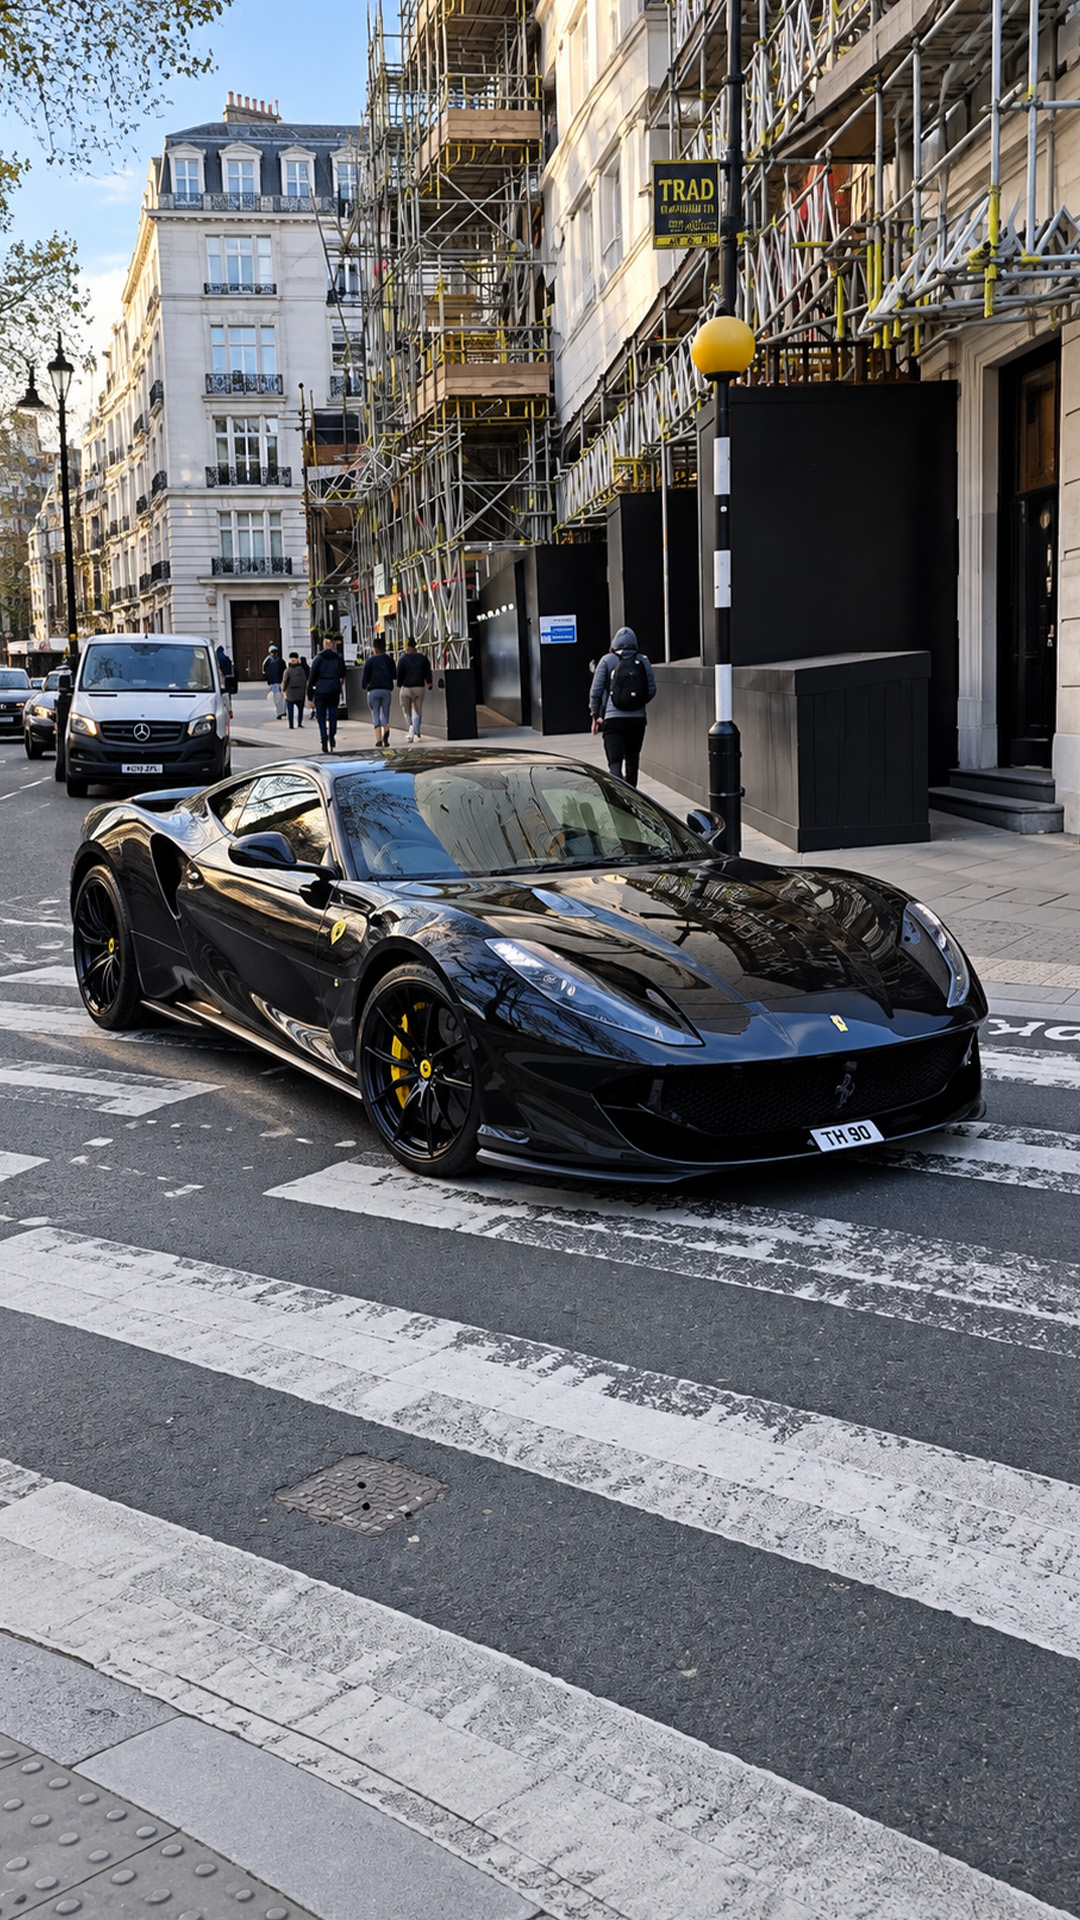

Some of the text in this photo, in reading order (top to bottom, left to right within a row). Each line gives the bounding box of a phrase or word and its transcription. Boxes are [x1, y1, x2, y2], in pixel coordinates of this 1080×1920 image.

[658, 178, 715, 201] TRAD
[820, 1125, 872, 1146] TH 90
